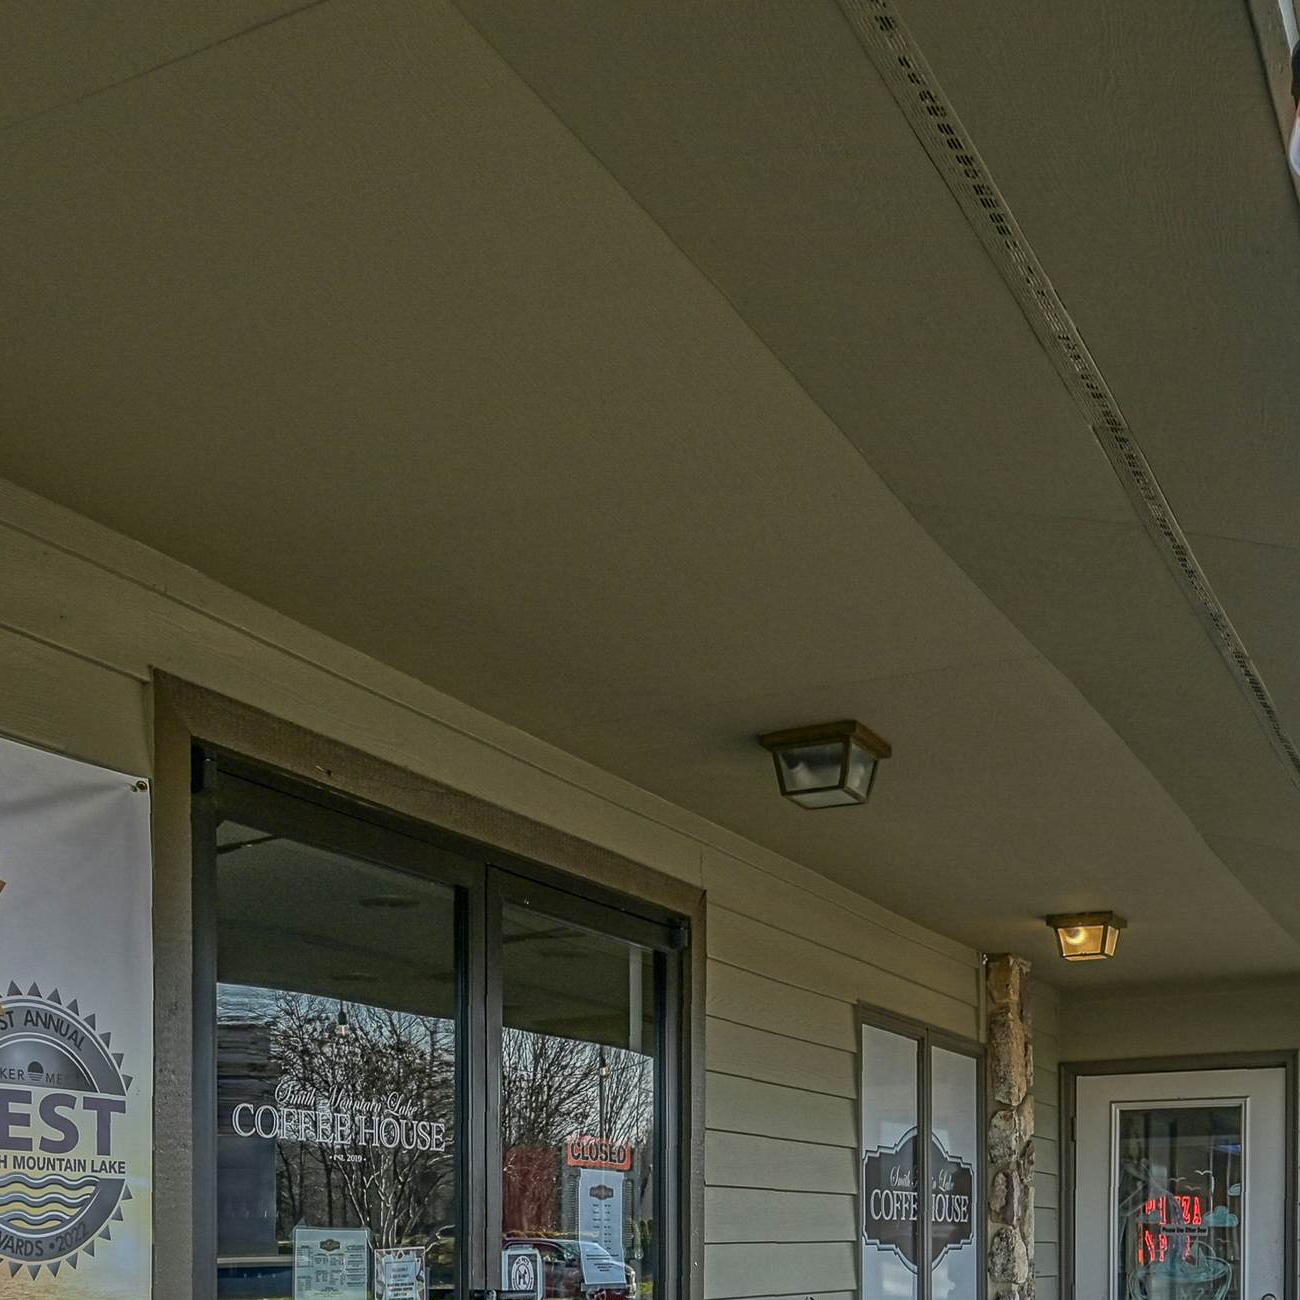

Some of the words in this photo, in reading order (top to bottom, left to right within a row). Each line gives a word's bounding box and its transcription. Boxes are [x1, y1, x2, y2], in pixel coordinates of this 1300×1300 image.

[23, 1009, 87, 1051] ANNUAL
[385, 1091, 419, 1117] Lake
[232, 1103, 351, 1145] COFFEE
[358, 1116, 446, 1152] HOUSE
[12, 1156, 86, 1173] MOUNTAIN
[90, 1160, 126, 1175] LAKE
[571, 1140, 626, 1164] CLOSED
[54, 1222, 88, 1252] 2022
